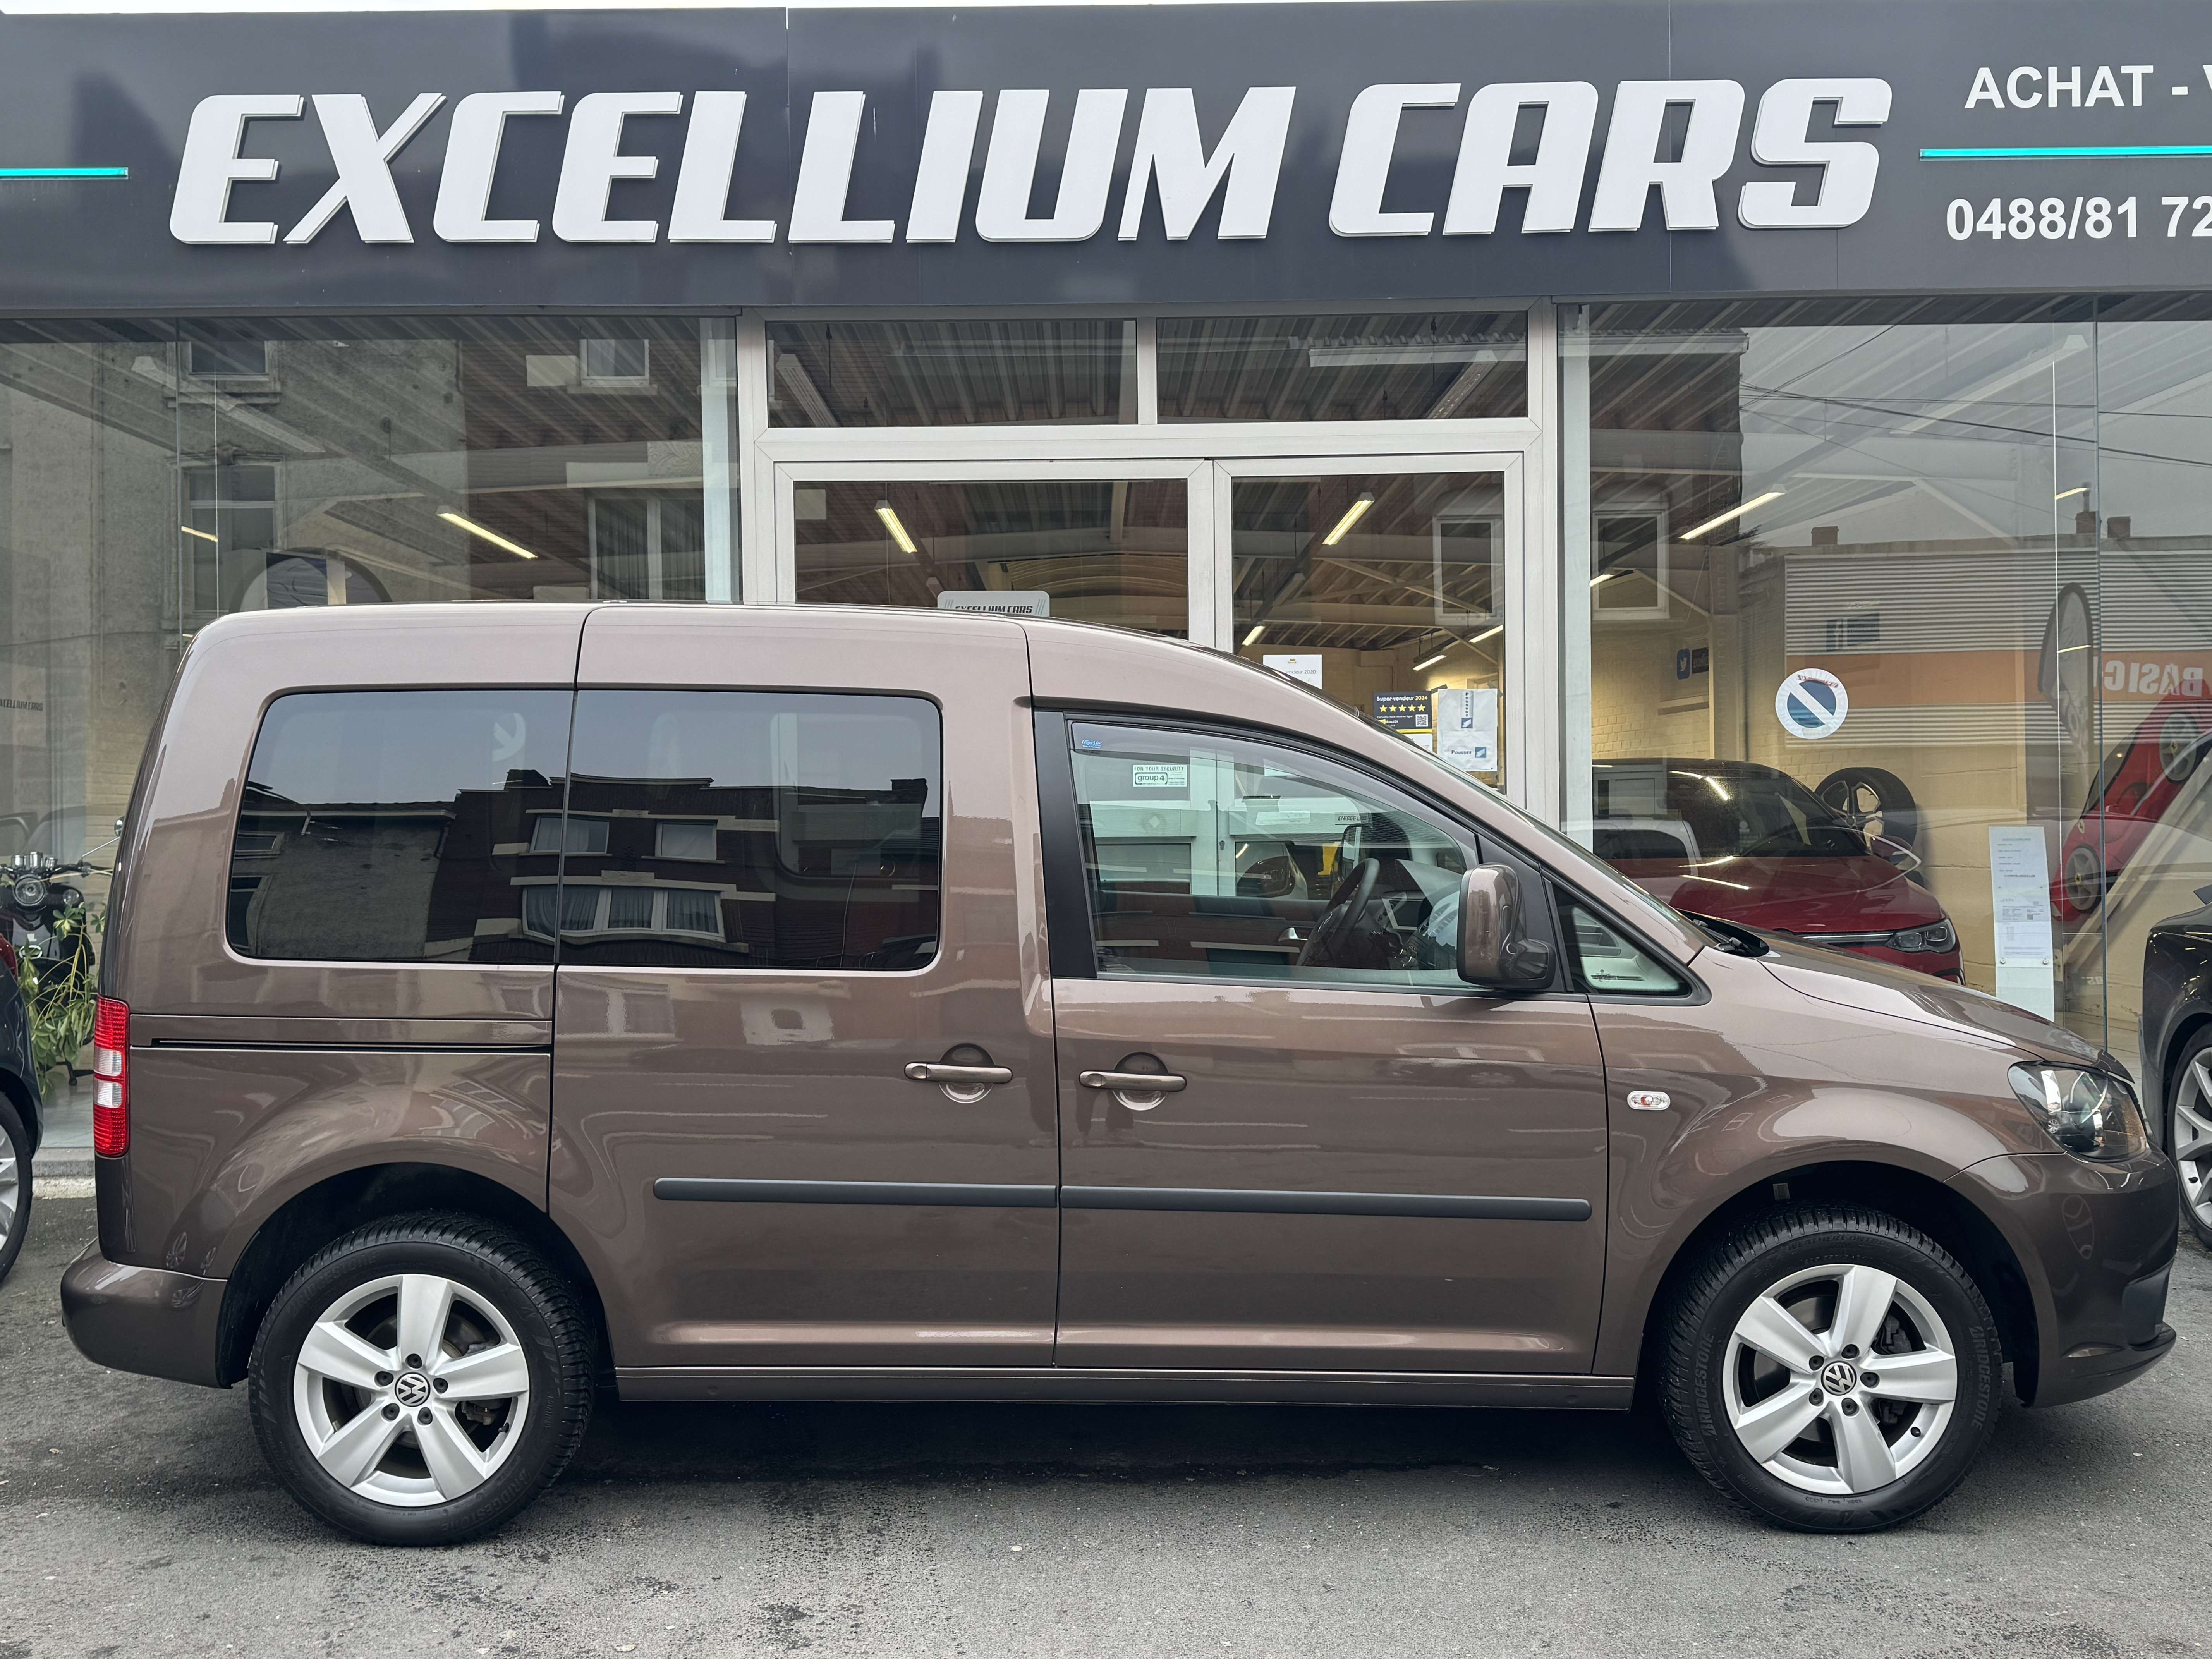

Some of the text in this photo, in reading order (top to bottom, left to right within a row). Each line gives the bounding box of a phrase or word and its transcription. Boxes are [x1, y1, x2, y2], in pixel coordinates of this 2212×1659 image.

[1964, 65, 2154, 108] ACHAT
[169, 77, 1893, 245] EXCELLIUM CARS
[1947, 196, 2137, 240] 0488/81
[1695, 1333, 1717, 1436] BRIDGESTONE
[1969, 1326, 1991, 1431] BRIDGESTONE
[441, 1467, 530, 1530] BRIDGESTONE
